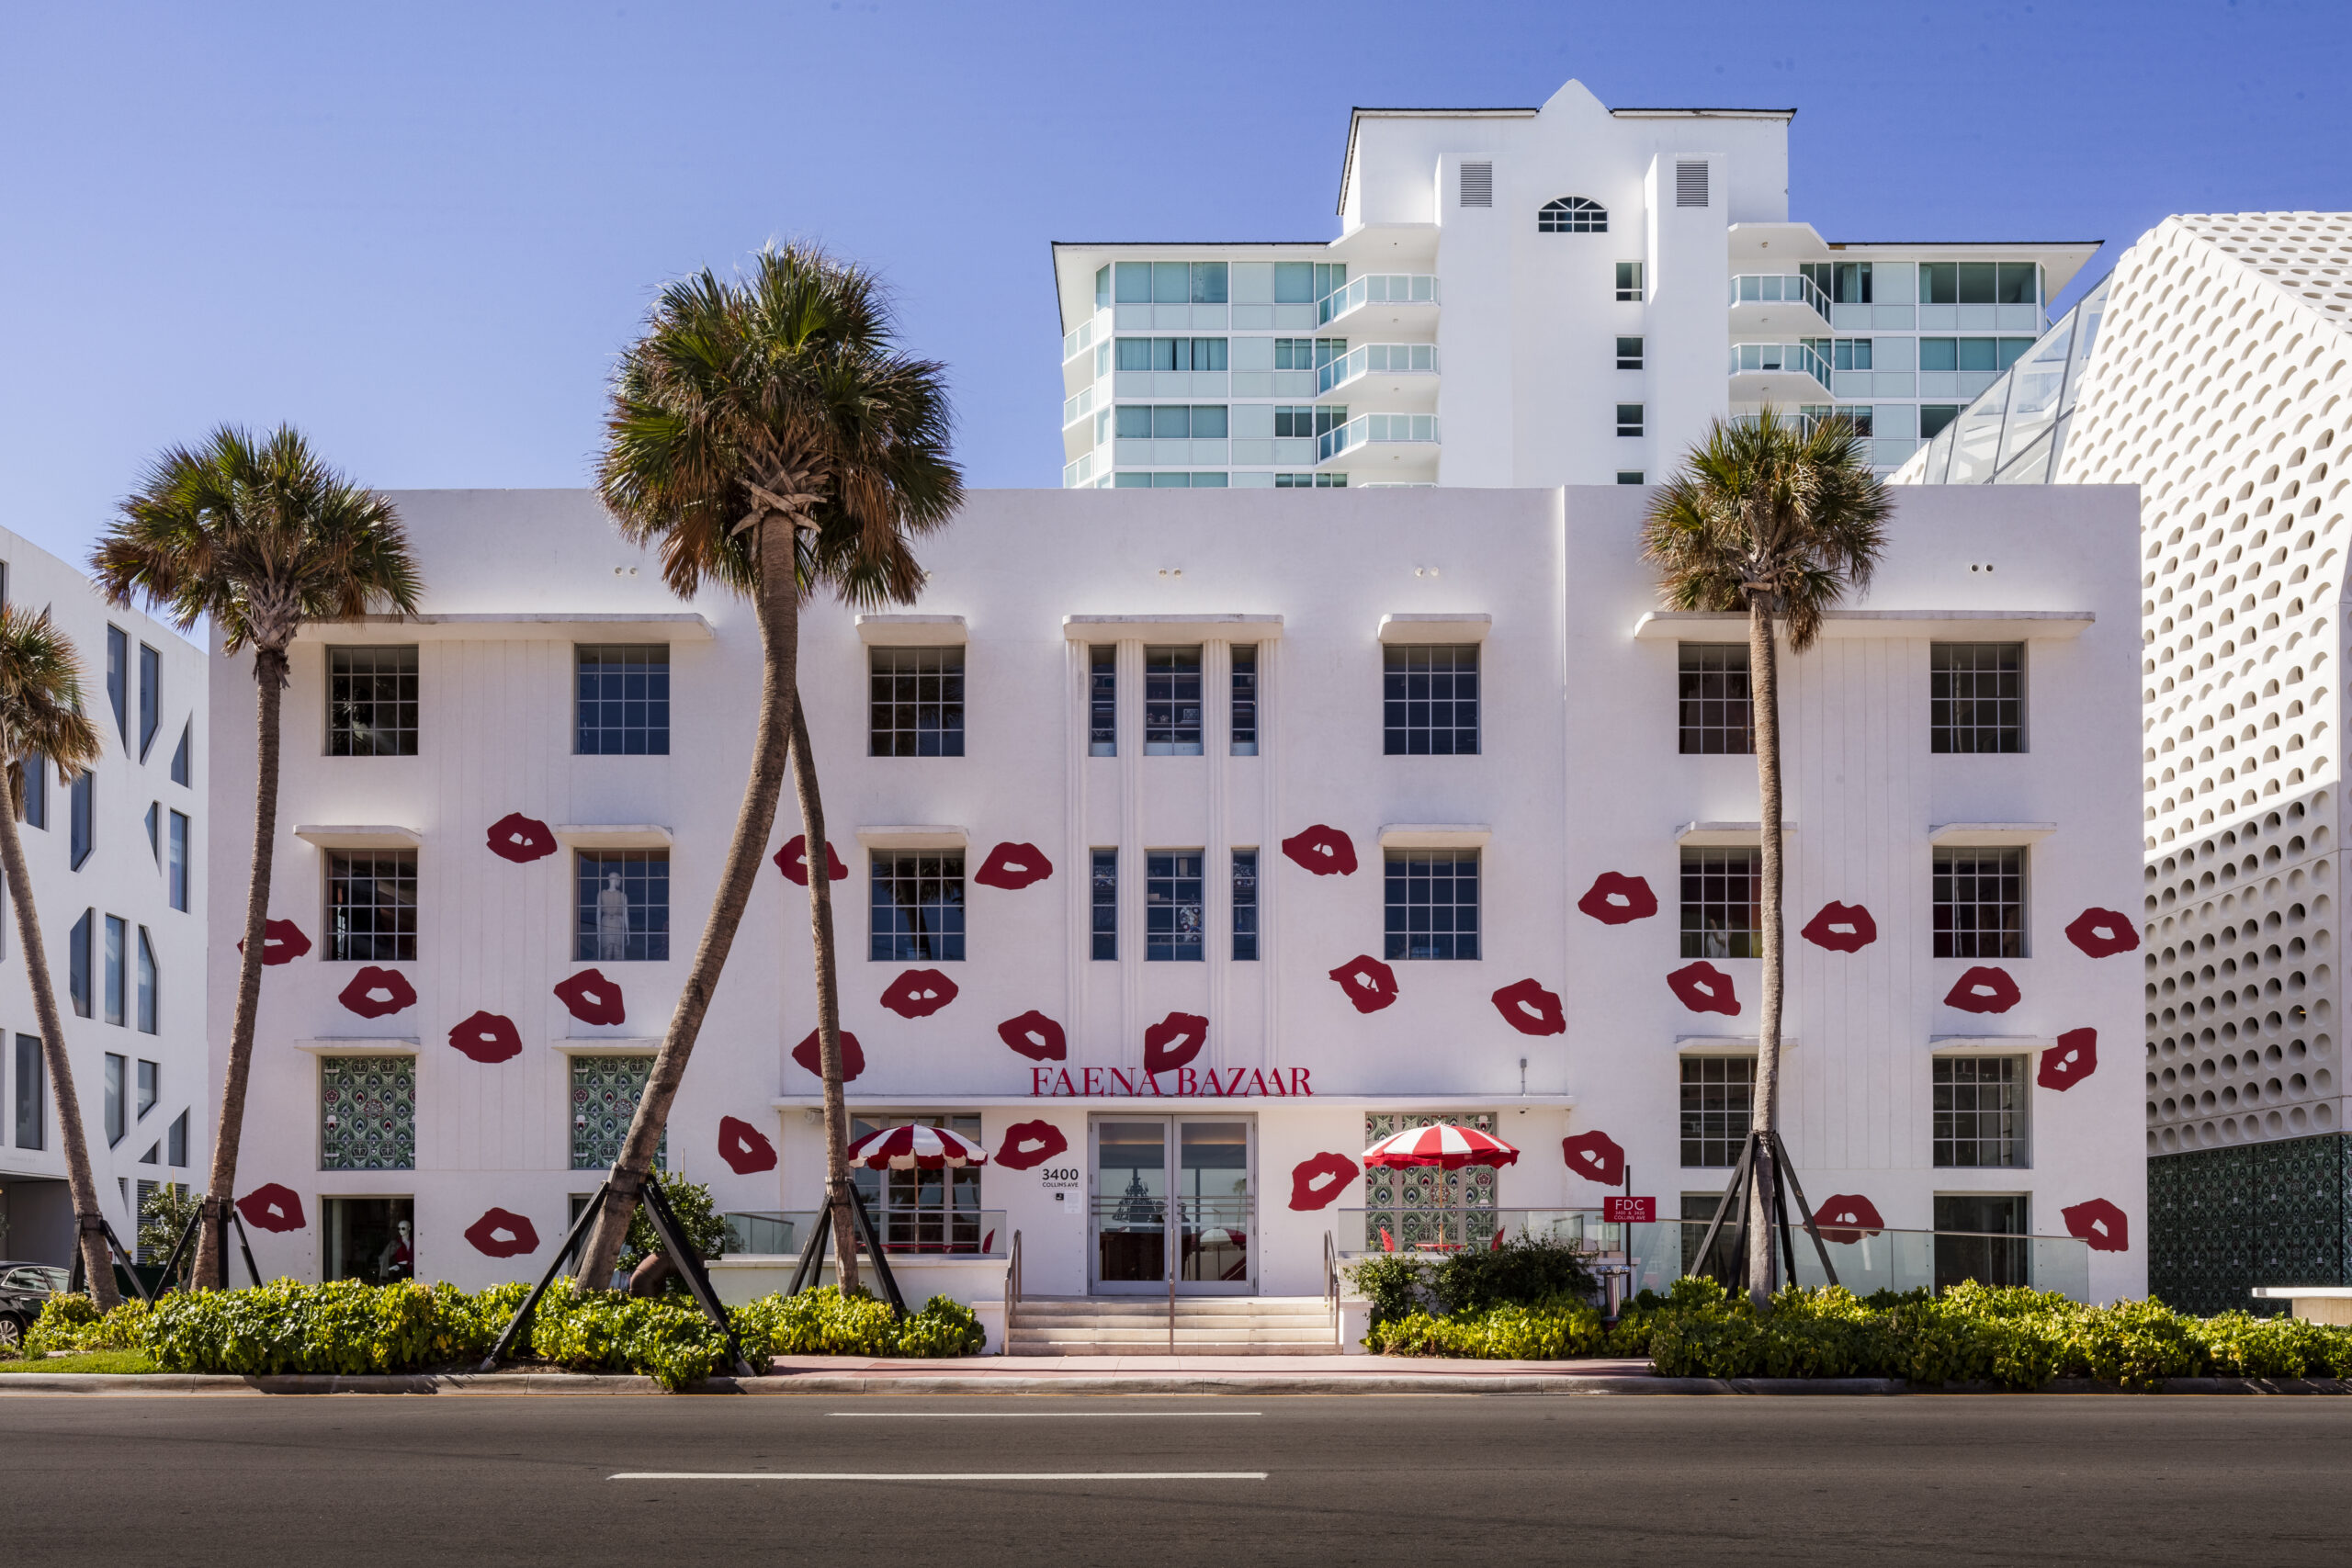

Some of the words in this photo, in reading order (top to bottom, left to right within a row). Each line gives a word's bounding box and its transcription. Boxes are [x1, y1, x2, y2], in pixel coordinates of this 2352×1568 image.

[1030, 1067, 1164, 1097] FAENA
[1175, 1067, 1314, 1097] BAZAAR
[1042, 1168, 1079, 1180] 3400
[1615, 1199, 1645, 1211] FDC
